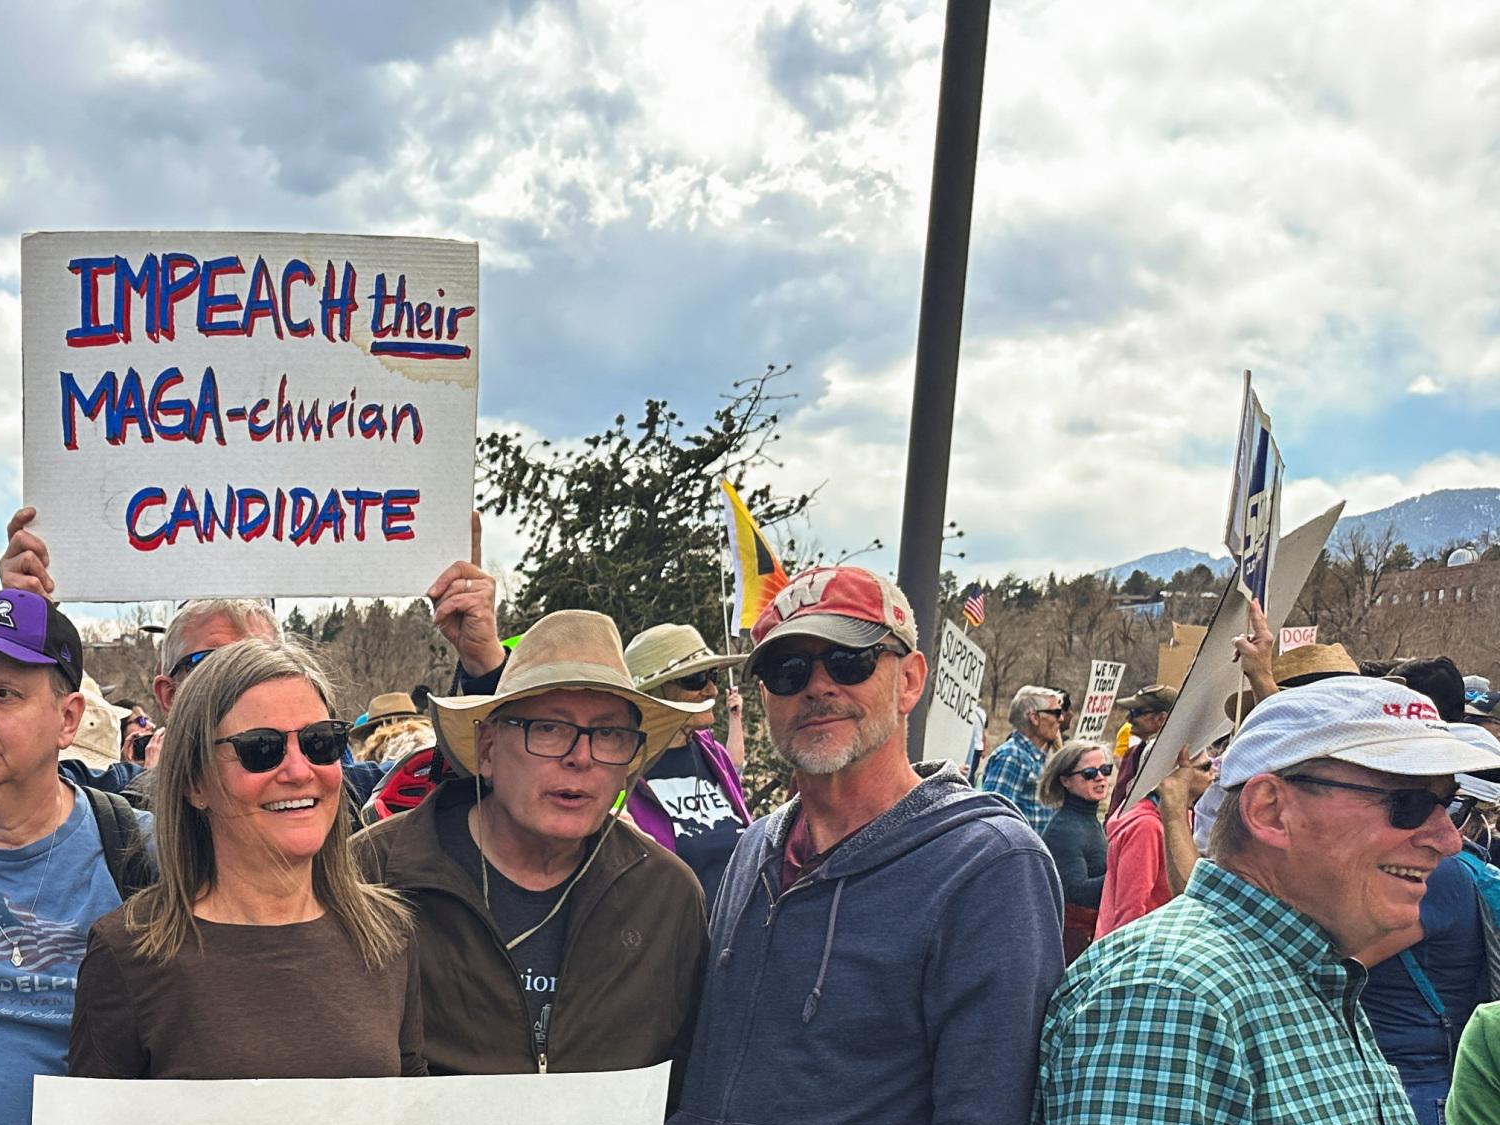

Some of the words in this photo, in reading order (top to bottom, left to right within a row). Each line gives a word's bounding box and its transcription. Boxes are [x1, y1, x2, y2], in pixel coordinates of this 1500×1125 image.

[66, 252, 359, 347] IMPEACH
[368, 272, 476, 346] their
[60, 366, 424, 450] MAGA-churian
[125, 484, 421, 552] CANDIDATE
[942, 630, 984, 689] SUPPORT
[1282, 627, 1316, 643] DOGE
[936, 666, 977, 726] SCIENCE
